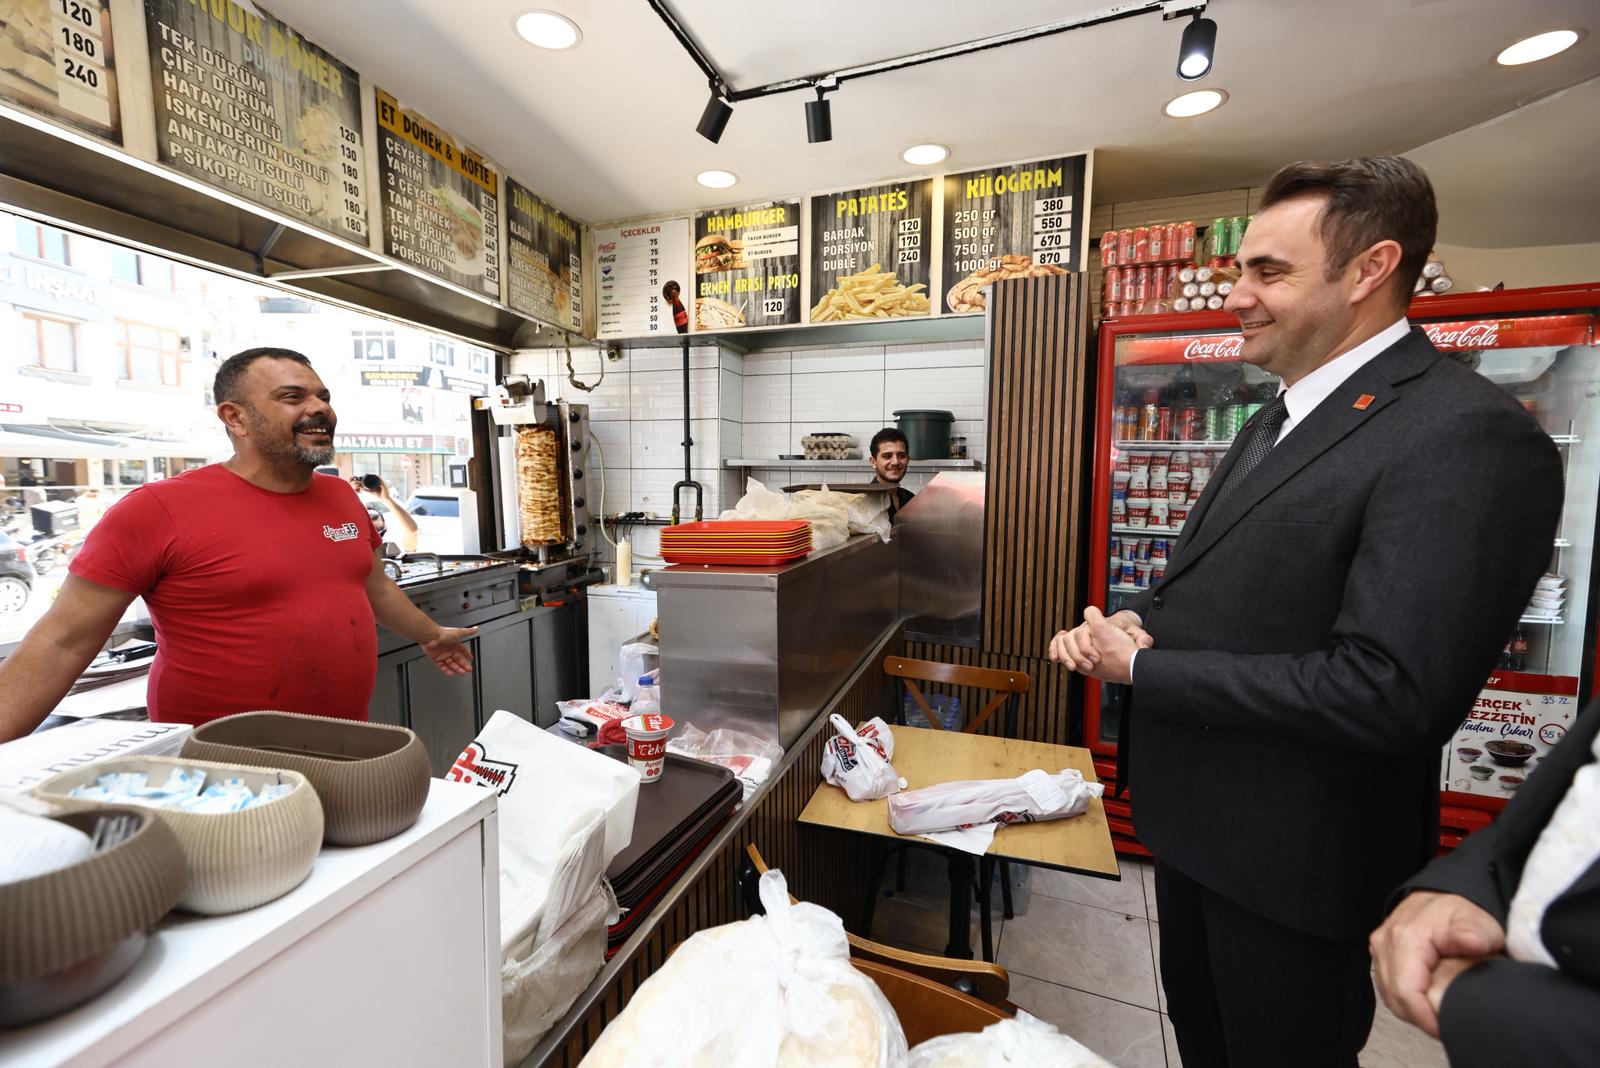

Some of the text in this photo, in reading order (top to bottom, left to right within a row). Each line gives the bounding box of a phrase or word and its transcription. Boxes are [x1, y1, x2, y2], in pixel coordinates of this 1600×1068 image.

[61, 0, 92, 26] 120
[62, 27, 95, 57] 180
[158, 21, 267, 96] TEK DÜRÜM
[64, 58, 98, 87] 240
[160, 47, 275, 120] ÇİFT DÜRÜM
[163, 70, 282, 143] HATAY USULÜ
[166, 94, 330, 185] İSKENDERUN USULÜ
[339, 126, 356, 144] 120
[381, 101, 395, 125] ET
[445, 143, 453, 161] &
[168, 119, 304, 191] ANTAKYA USULÜ
[341, 144, 357, 162] 130
[385, 137, 429, 172] ÇEYREK
[342, 162, 358, 180] 180
[386, 154, 422, 184] YARIM
[170, 142, 312, 214] PSİKOPAT USULÜ
[966, 166, 1062, 199] KİLOGRAM
[343, 181, 359, 197] 180
[387, 172, 441, 210] 3 ÇEYREK
[344, 199, 360, 215] 180
[388, 189, 452, 231] TAM EKMEK
[836, 191, 908, 219] PATATES
[1042, 199, 1063, 212] 380
[346, 216, 361, 232] 180
[389, 207, 410, 226] TEK
[707, 207, 785, 233] HAMBURGER
[954, 208, 996, 223] 250 gr
[1041, 217, 1062, 229] 550
[620, 226, 661, 238] İÇECEKLER
[823, 227, 865, 241] BARDAK
[901, 220, 919, 232] 120
[954, 226, 995, 239] 500 gr
[391, 225, 416, 245] ÇİFT
[901, 235, 919, 247] 170
[1040, 235, 1061, 246] 670
[823, 241, 875, 256] PORSİYON
[900, 251, 918, 262] 240
[954, 243, 995, 256] 750 gr
[392, 242, 446, 273] PORSİYON
[823, 258, 856, 271] DUBLE
[954, 259, 1002, 272] 1000 gr
[1039, 252, 1060, 264] 870
[700, 274, 799, 296] EKMEK ARASI PATSO
[765, 301, 782, 312] 120
[1184, 336, 1245, 359] Coca-Col
[406, 437, 424, 449] ET
[344, 523, 357, 533] 35
[1474, 697, 1522, 712] ERÇEK
[1467, 710, 1536, 726] EZZETİN
[1500, 722, 1534, 739] Çıkar
[1542, 729, 1555, 739] 35
